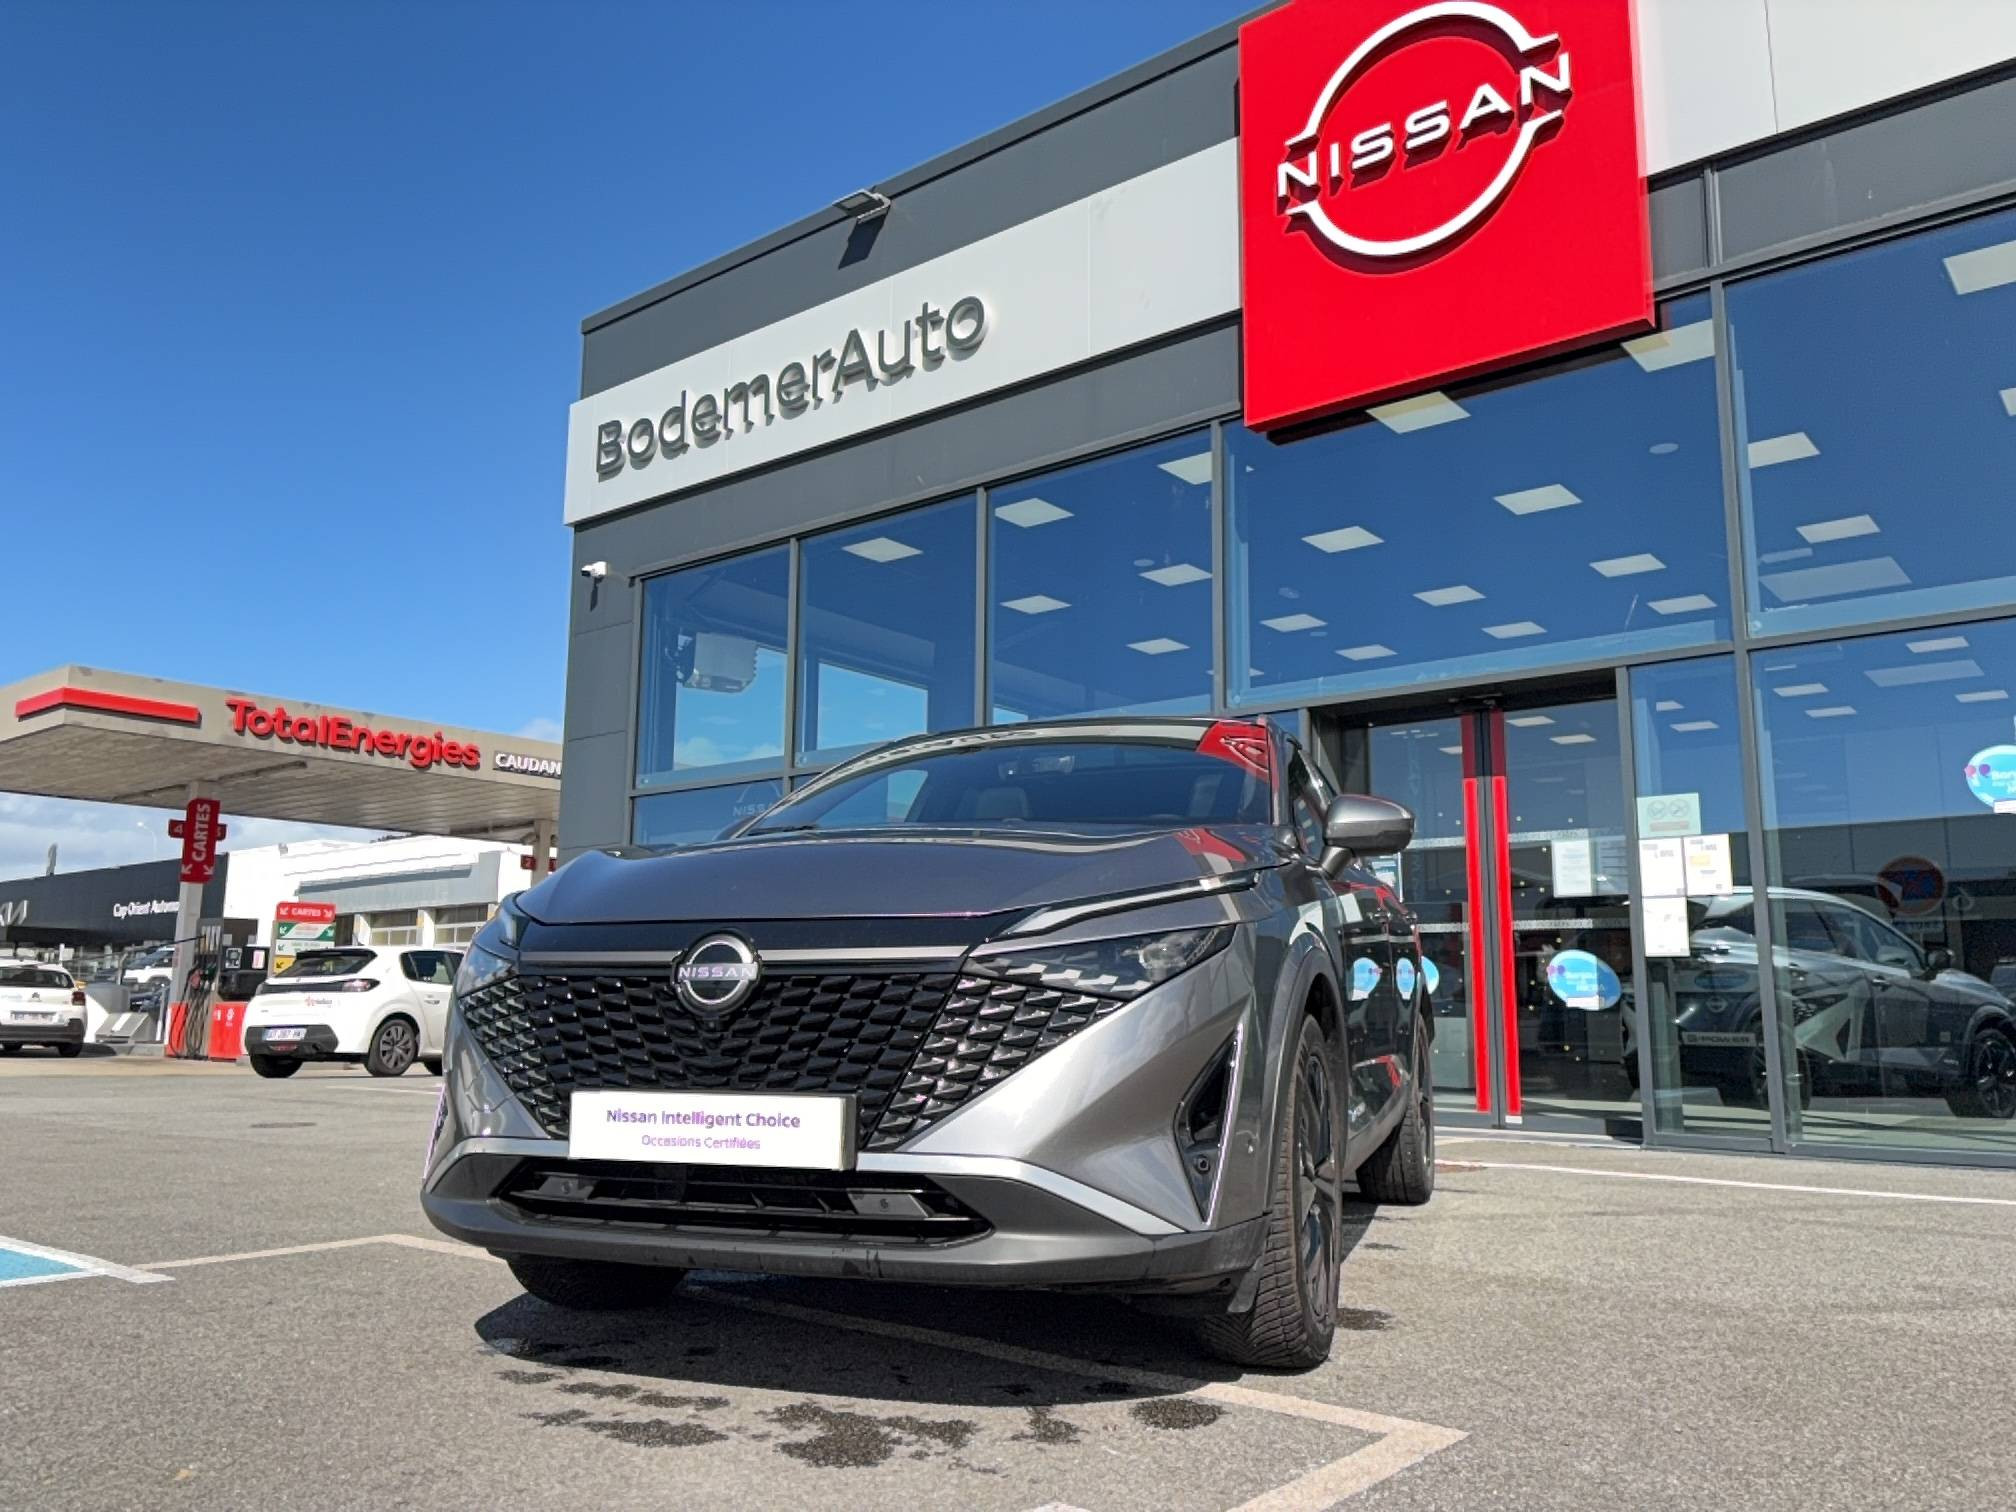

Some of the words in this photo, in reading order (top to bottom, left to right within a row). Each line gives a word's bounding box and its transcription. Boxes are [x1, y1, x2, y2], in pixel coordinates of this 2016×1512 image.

[1277, 52, 1572, 199] NISSAN
[596, 294, 988, 478] BodemerAuto
[225, 695, 482, 769] TotalEnergies
[495, 752, 562, 776] CAUDAN
[191, 802, 212, 862] CARTES
[291, 907, 321, 917] CARTES
[678, 963, 756, 980] NISSAN
[606, 1108, 657, 1123] Nissan
[661, 1110, 742, 1129] Intelligent
[745, 1112, 801, 1128] Choice
[641, 1134, 702, 1148] Occasions
[703, 1135, 761, 1150] Certifiées
